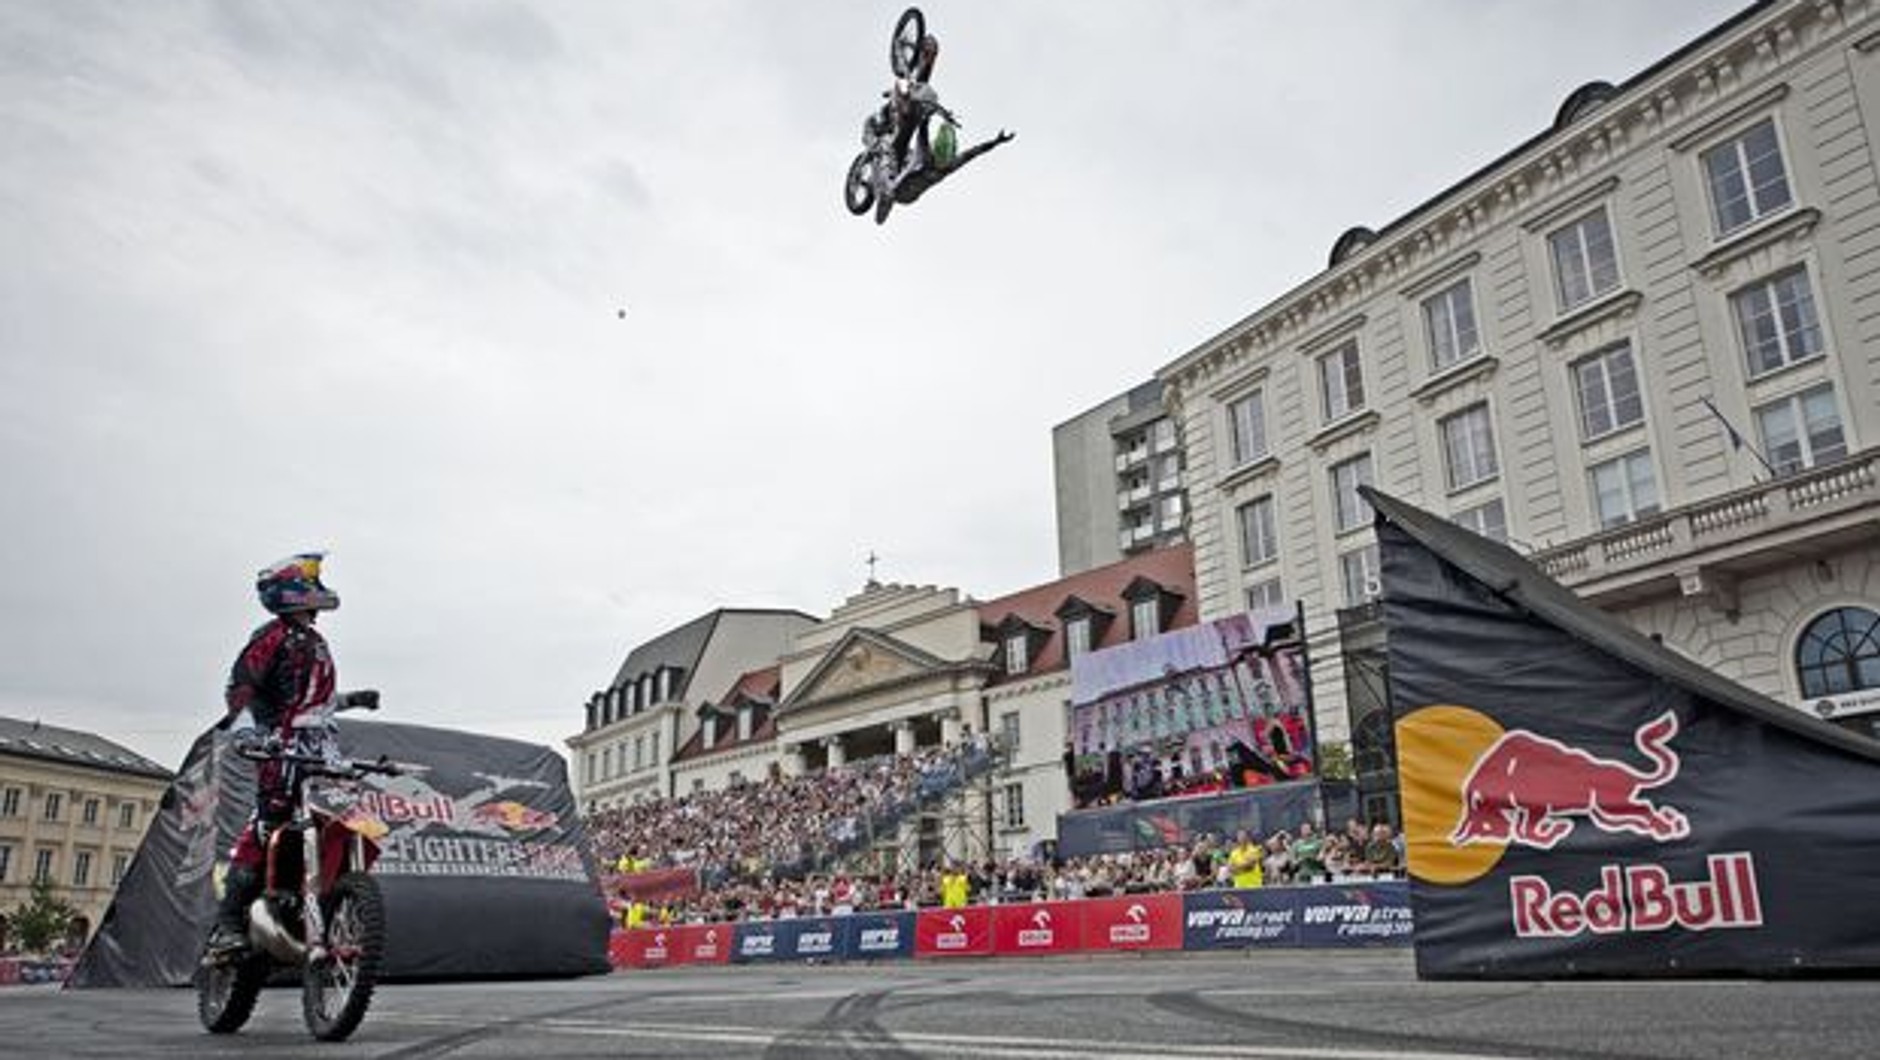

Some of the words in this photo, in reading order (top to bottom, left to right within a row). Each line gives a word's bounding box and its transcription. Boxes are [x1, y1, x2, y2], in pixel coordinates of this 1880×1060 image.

[385, 795, 455, 823] Bull
[1510, 864, 1627, 937] Red
[1625, 851, 1763, 931] Bull
